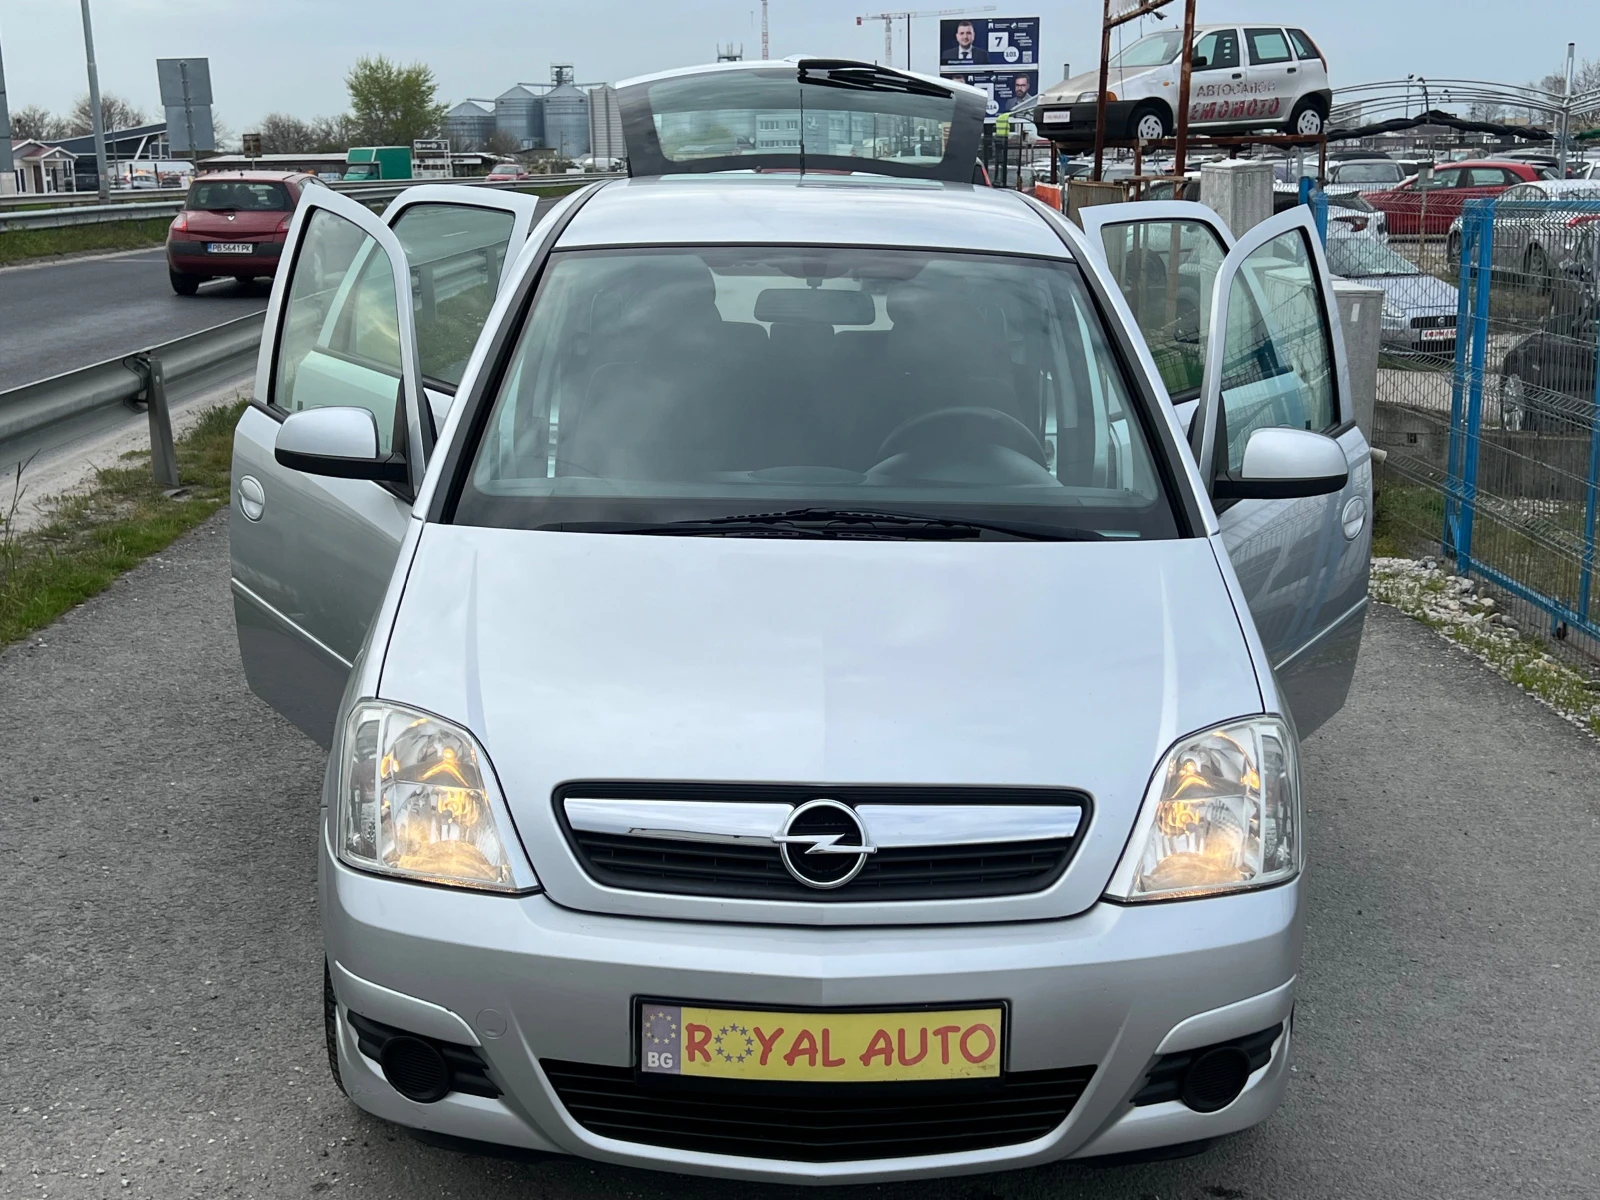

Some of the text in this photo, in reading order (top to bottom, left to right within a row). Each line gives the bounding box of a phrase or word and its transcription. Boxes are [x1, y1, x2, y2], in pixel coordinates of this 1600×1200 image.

[995, 36, 1003, 47] 7
[685, 1022, 996, 1068] ROYAL AUTO
[647, 1051, 673, 1069] BG
